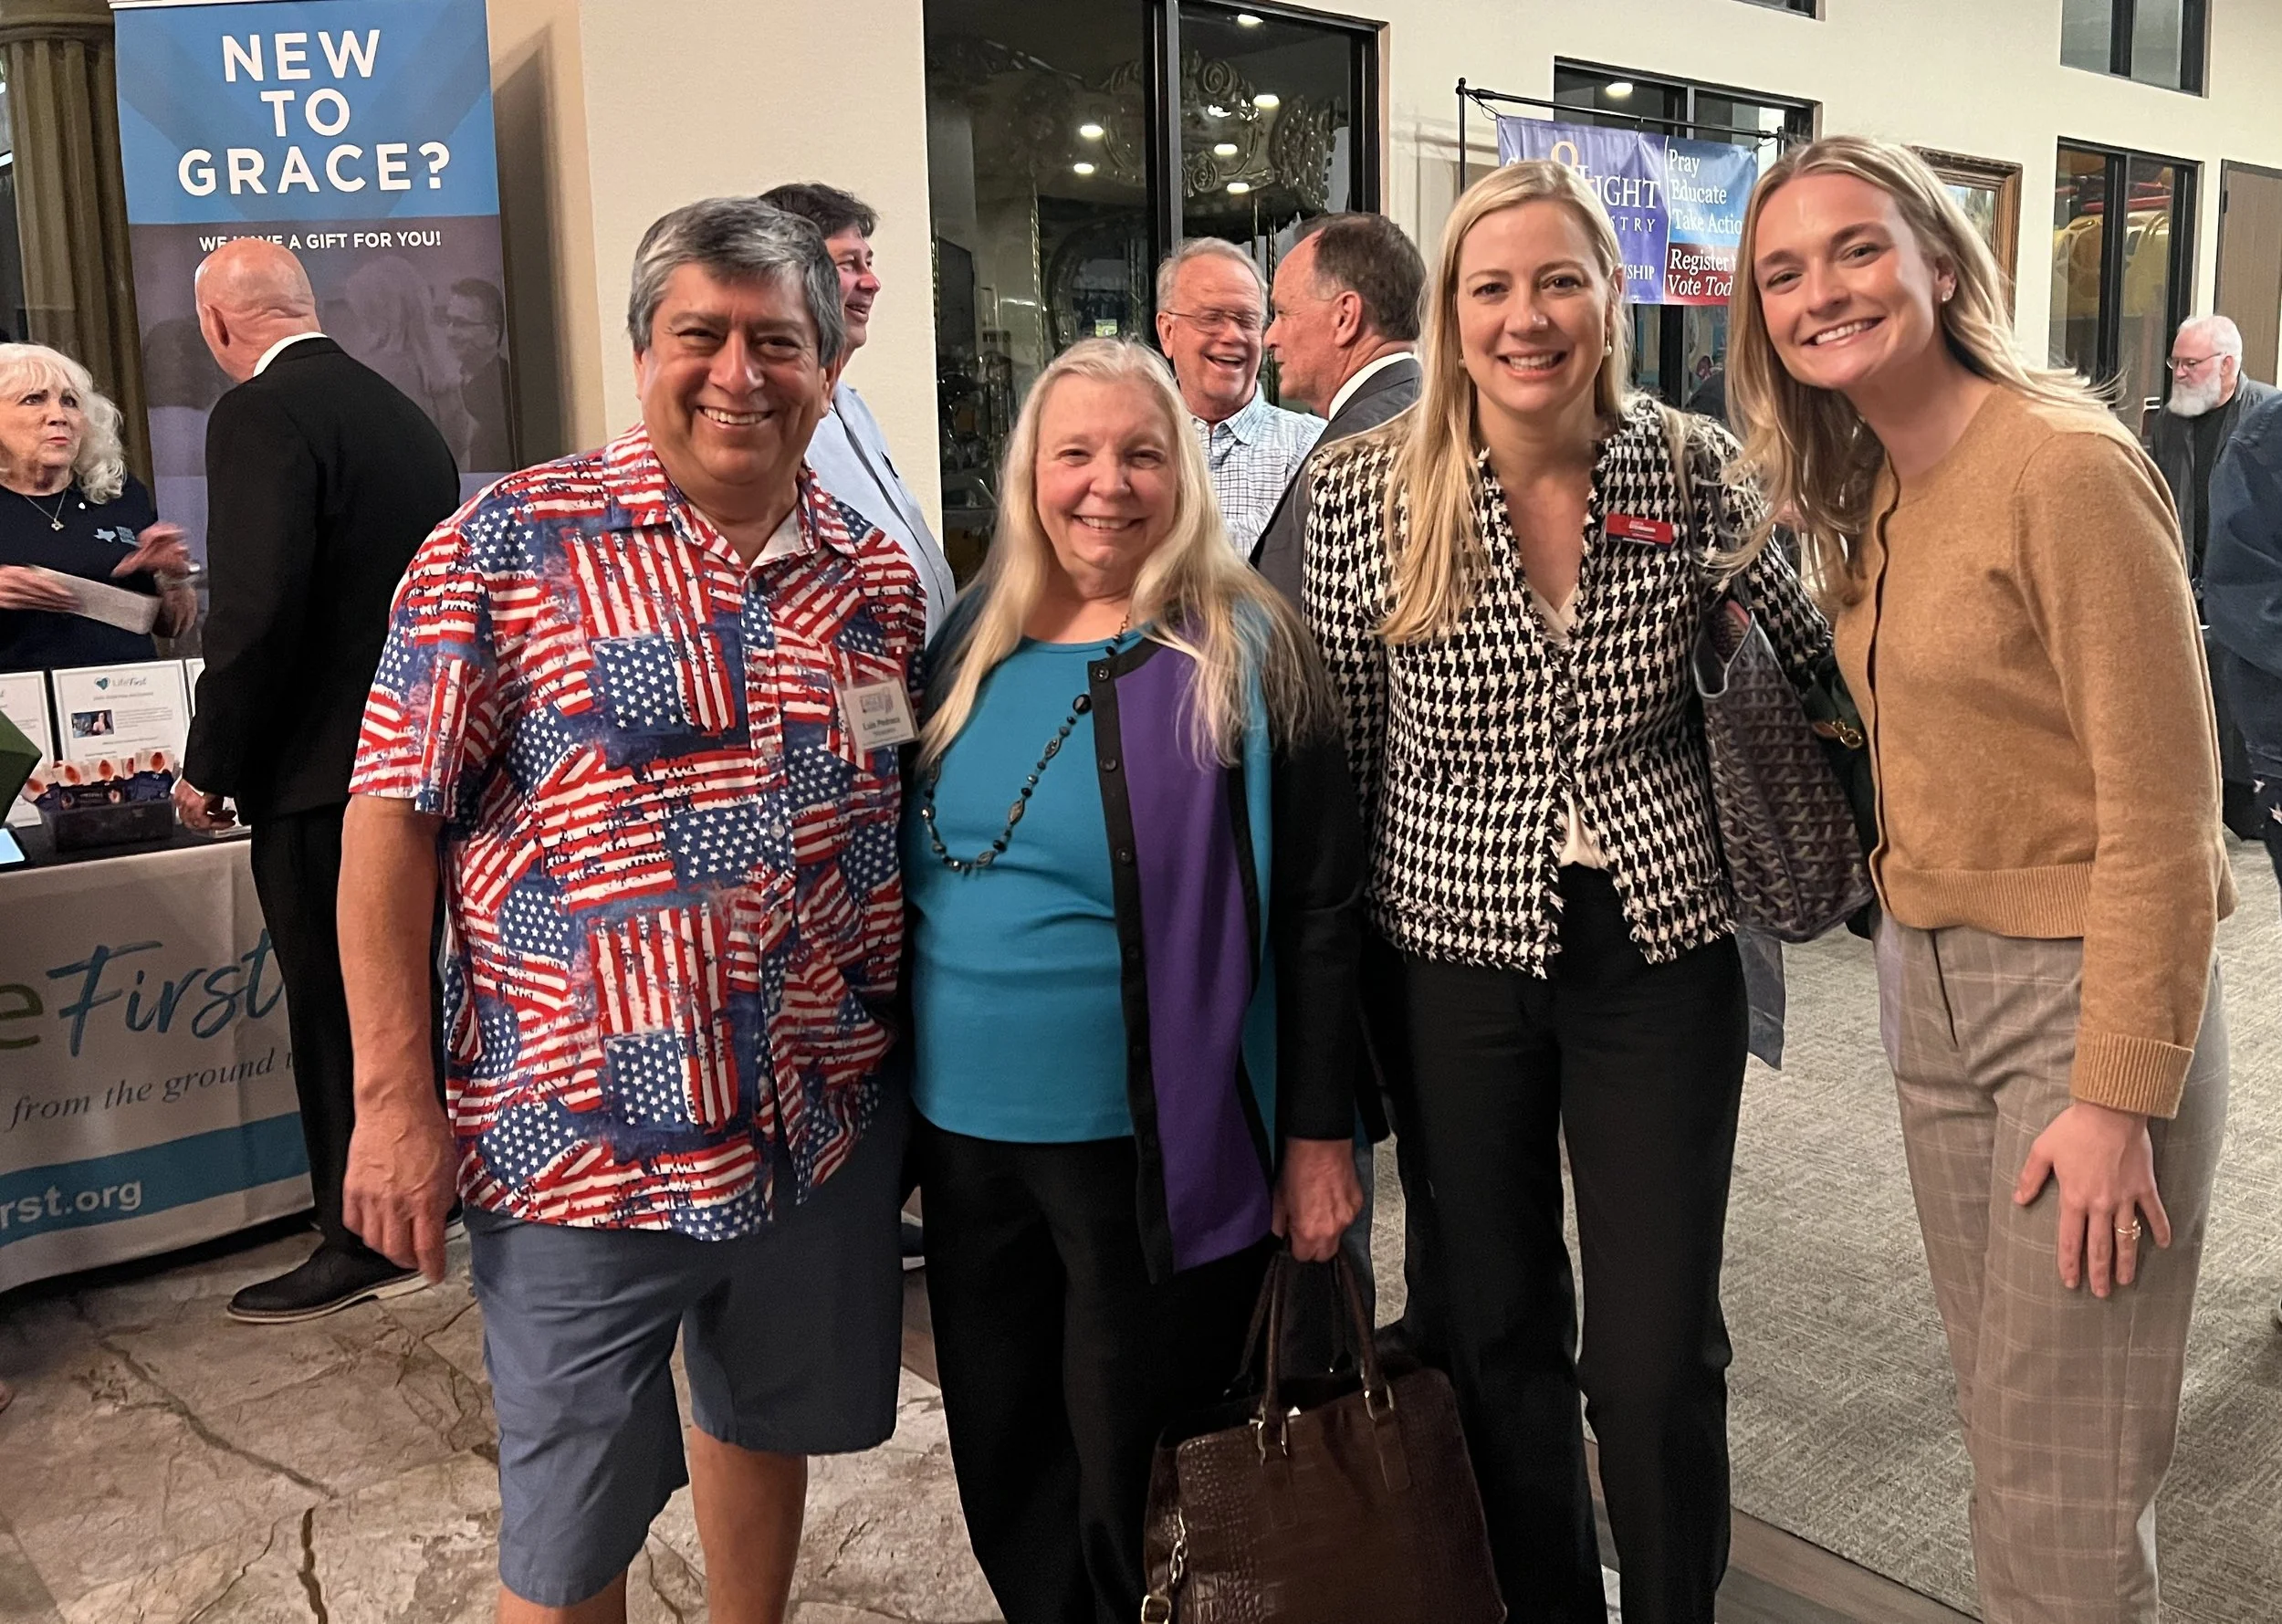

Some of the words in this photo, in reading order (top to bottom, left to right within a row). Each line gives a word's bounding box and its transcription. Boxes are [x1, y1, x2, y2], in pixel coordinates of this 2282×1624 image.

[222, 29, 380, 82] NEW
[260, 88, 351, 137] TO
[178, 141, 450, 196] GRACE?
[1669, 149, 1701, 178] Pray
[1670, 179, 1727, 204] Educate
[1609, 215, 1656, 233] STRY
[1671, 208, 1704, 232] Take
[1708, 213, 1743, 236] Actio
[199, 236, 227, 252] WE
[288, 234, 302, 250] A
[306, 233, 348, 249] GIFT
[353, 232, 393, 248] FOR
[396, 231, 442, 246] YOU!
[1623, 263, 1655, 280] SHIP
[1670, 248, 1730, 276] Register
[1667, 274, 1701, 296] Vote
[1705, 275, 1734, 297] Tod
[0, 928, 285, 1057] eFirst
[7, 1095, 90, 1133] from
[105, 1080, 152, 1110] the
[162, 1047, 275, 1104] ground
[0, 1180, 142, 1230] rst.org
